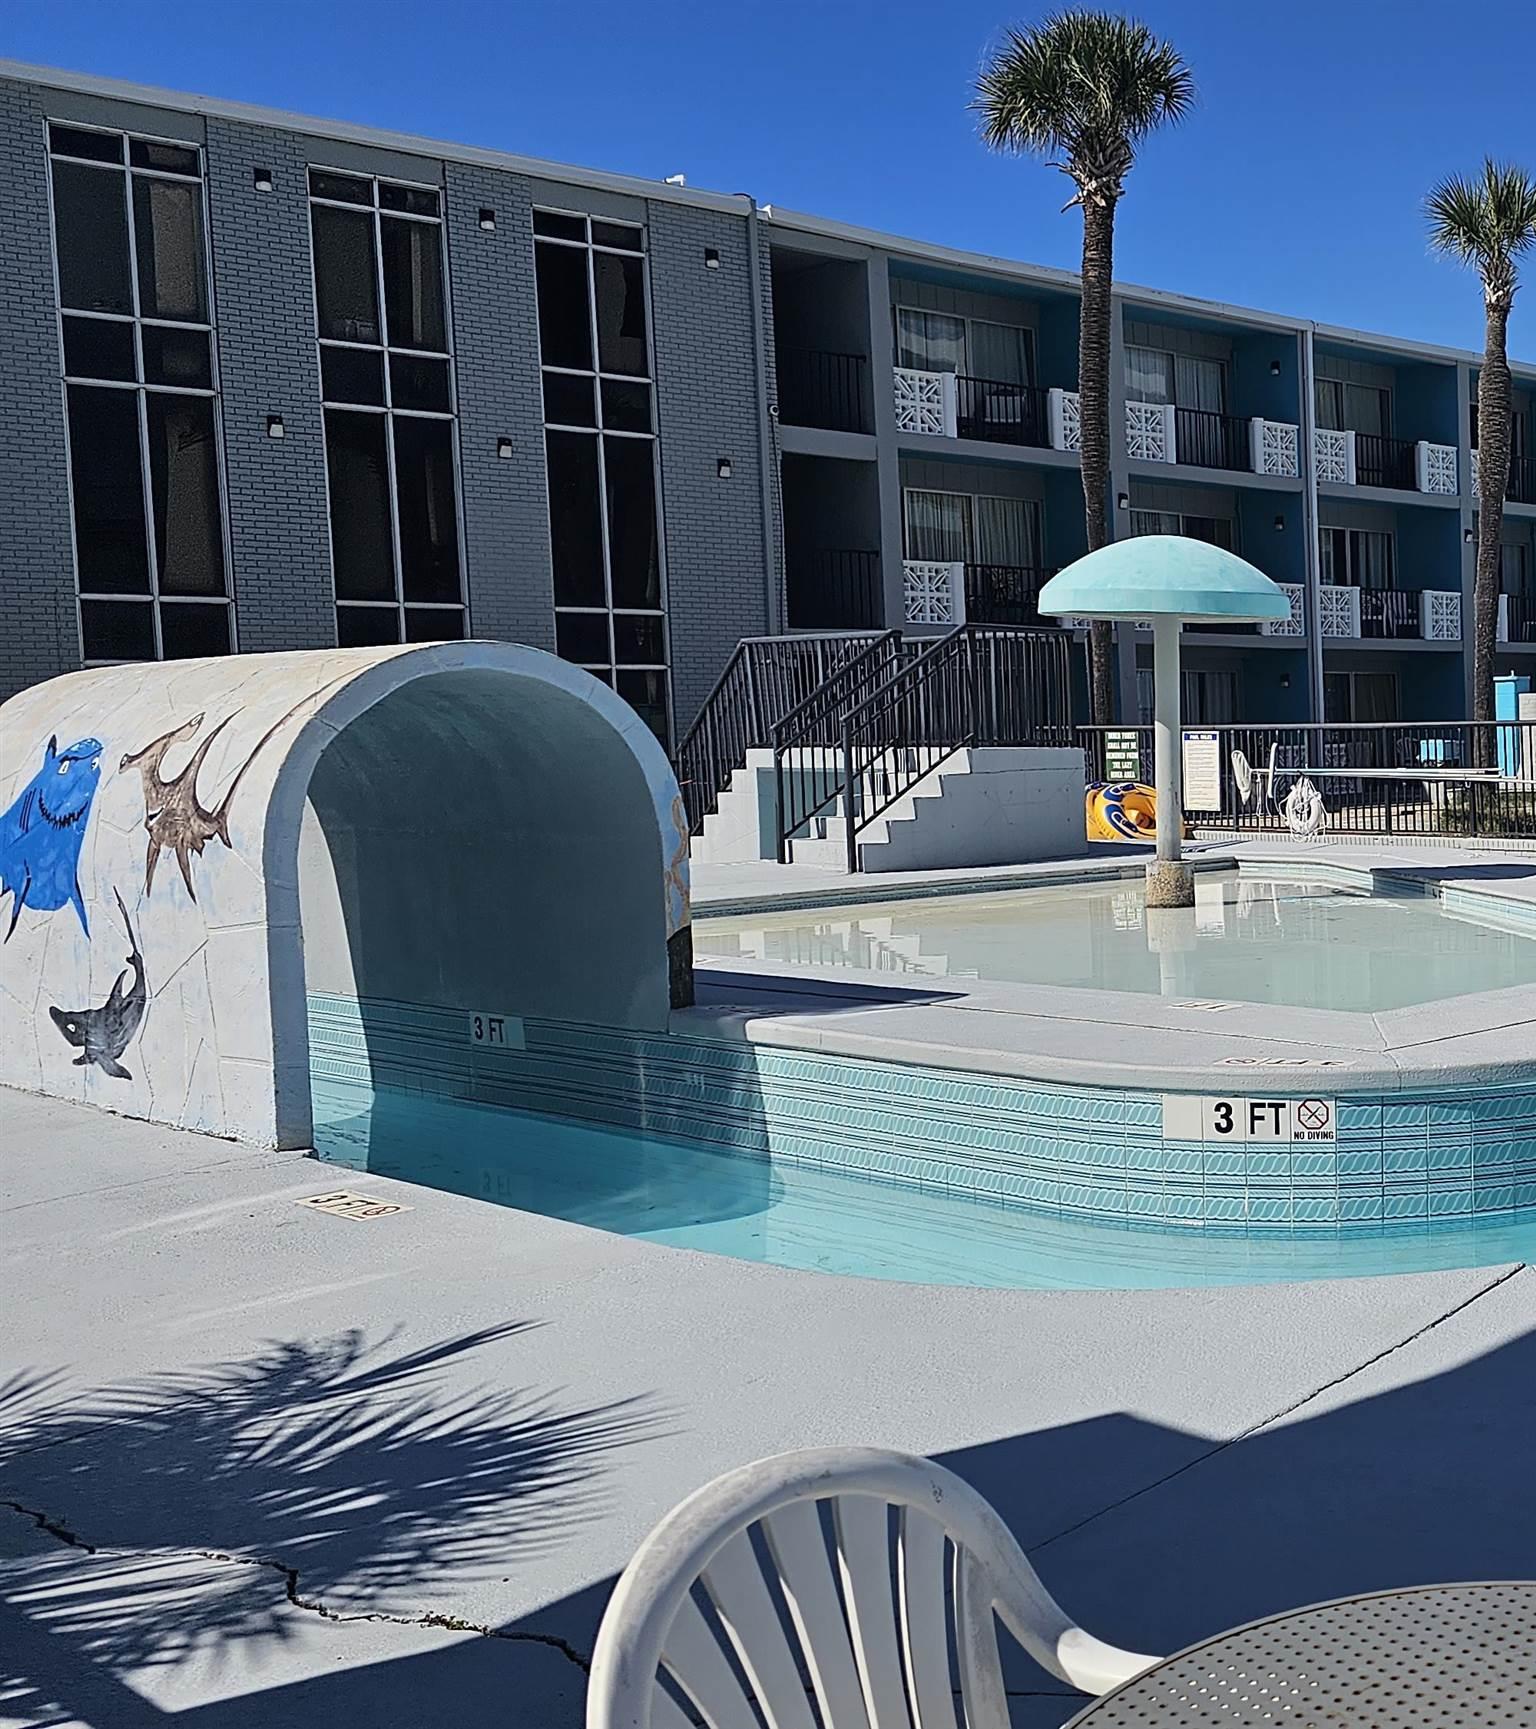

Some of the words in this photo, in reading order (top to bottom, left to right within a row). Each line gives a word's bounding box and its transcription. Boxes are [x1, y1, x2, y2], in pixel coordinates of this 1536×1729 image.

[474, 1016, 483, 1040] 3
[488, 1018, 504, 1043] FT
[1214, 1101, 1234, 1134] 3
[1250, 1102, 1286, 1135] FT
[1294, 1131, 1305, 1140] NO
[1307, 1130, 1334, 1140] DIVING
